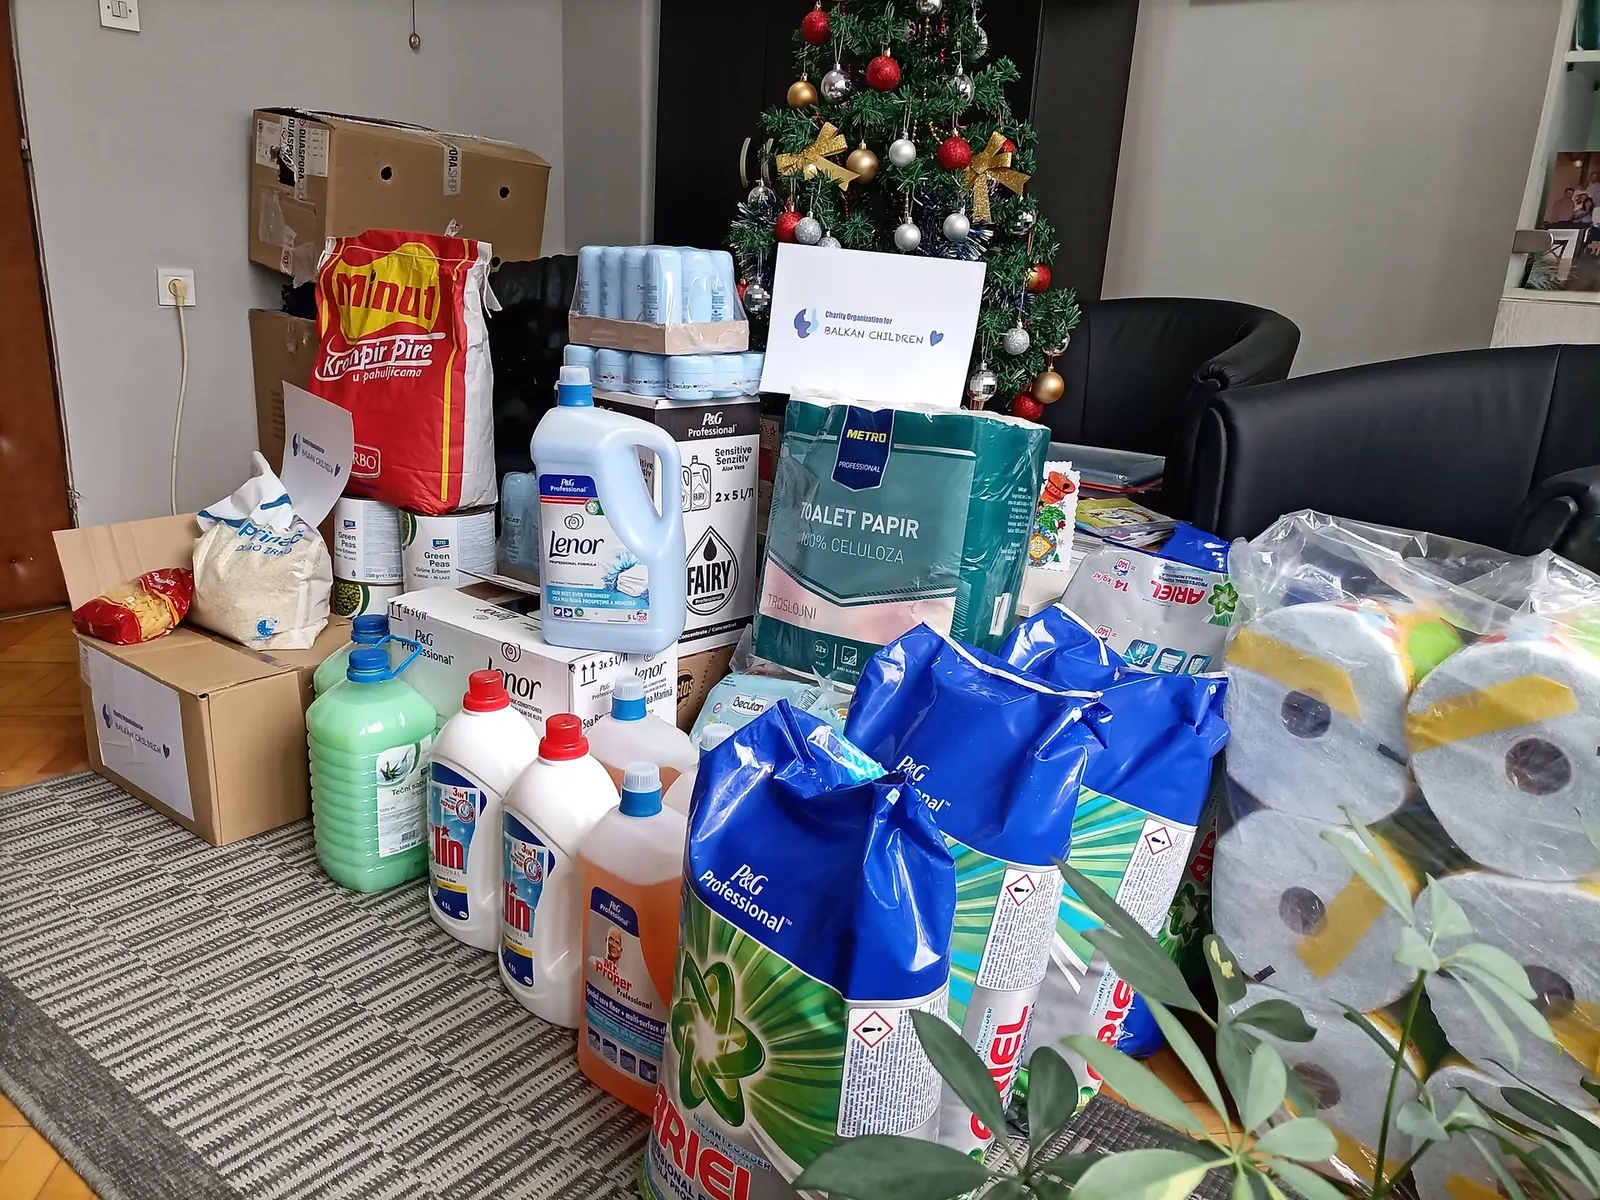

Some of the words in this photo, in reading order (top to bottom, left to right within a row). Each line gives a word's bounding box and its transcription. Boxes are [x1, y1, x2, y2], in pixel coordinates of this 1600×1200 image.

[825, 310, 846, 320] Charity
[847, 313, 883, 324] Organization
[824, 326, 865, 338] BALKAN
[868, 331, 924, 344] CHILDREN
[391, 338, 433, 363] Pire
[363, 366, 422, 383] pahuljicama
[702, 411, 723, 426] P&G
[846, 428, 887, 443] METRO
[715, 445, 752, 456] Sensitive
[716, 454, 750, 465] Senzitiv
[353, 451, 376, 469] RBO
[838, 461, 881, 473] PROFESSIONAL
[715, 492, 721, 502] 2
[724, 493, 730, 501] x
[732, 490, 738, 500] 5
[800, 501, 857, 529] TOALET
[860, 512, 920, 539] PAPIR
[549, 530, 604, 559] Lenor
[831, 537, 904, 564] CELULOZA
[424, 551, 450, 560] Green
[686, 560, 732, 596] FAIRY
[1114, 579, 1129, 592] 14
[1150, 579, 1206, 606] ARIEL
[768, 593, 817, 620] TROSLOJNI
[415, 629, 434, 647] P&G
[401, 640, 452, 666] Prossional
[732, 696, 765, 713] Becutan
[582, 718, 594, 729] Sea
[434, 825, 464, 871] lin
[730, 863, 769, 896] P&G
[504, 882, 530, 932] lin
[616, 987, 653, 1010] Professional
[693, 1111, 726, 1144] INSTANT
[727, 1141, 772, 1171] POWDER
